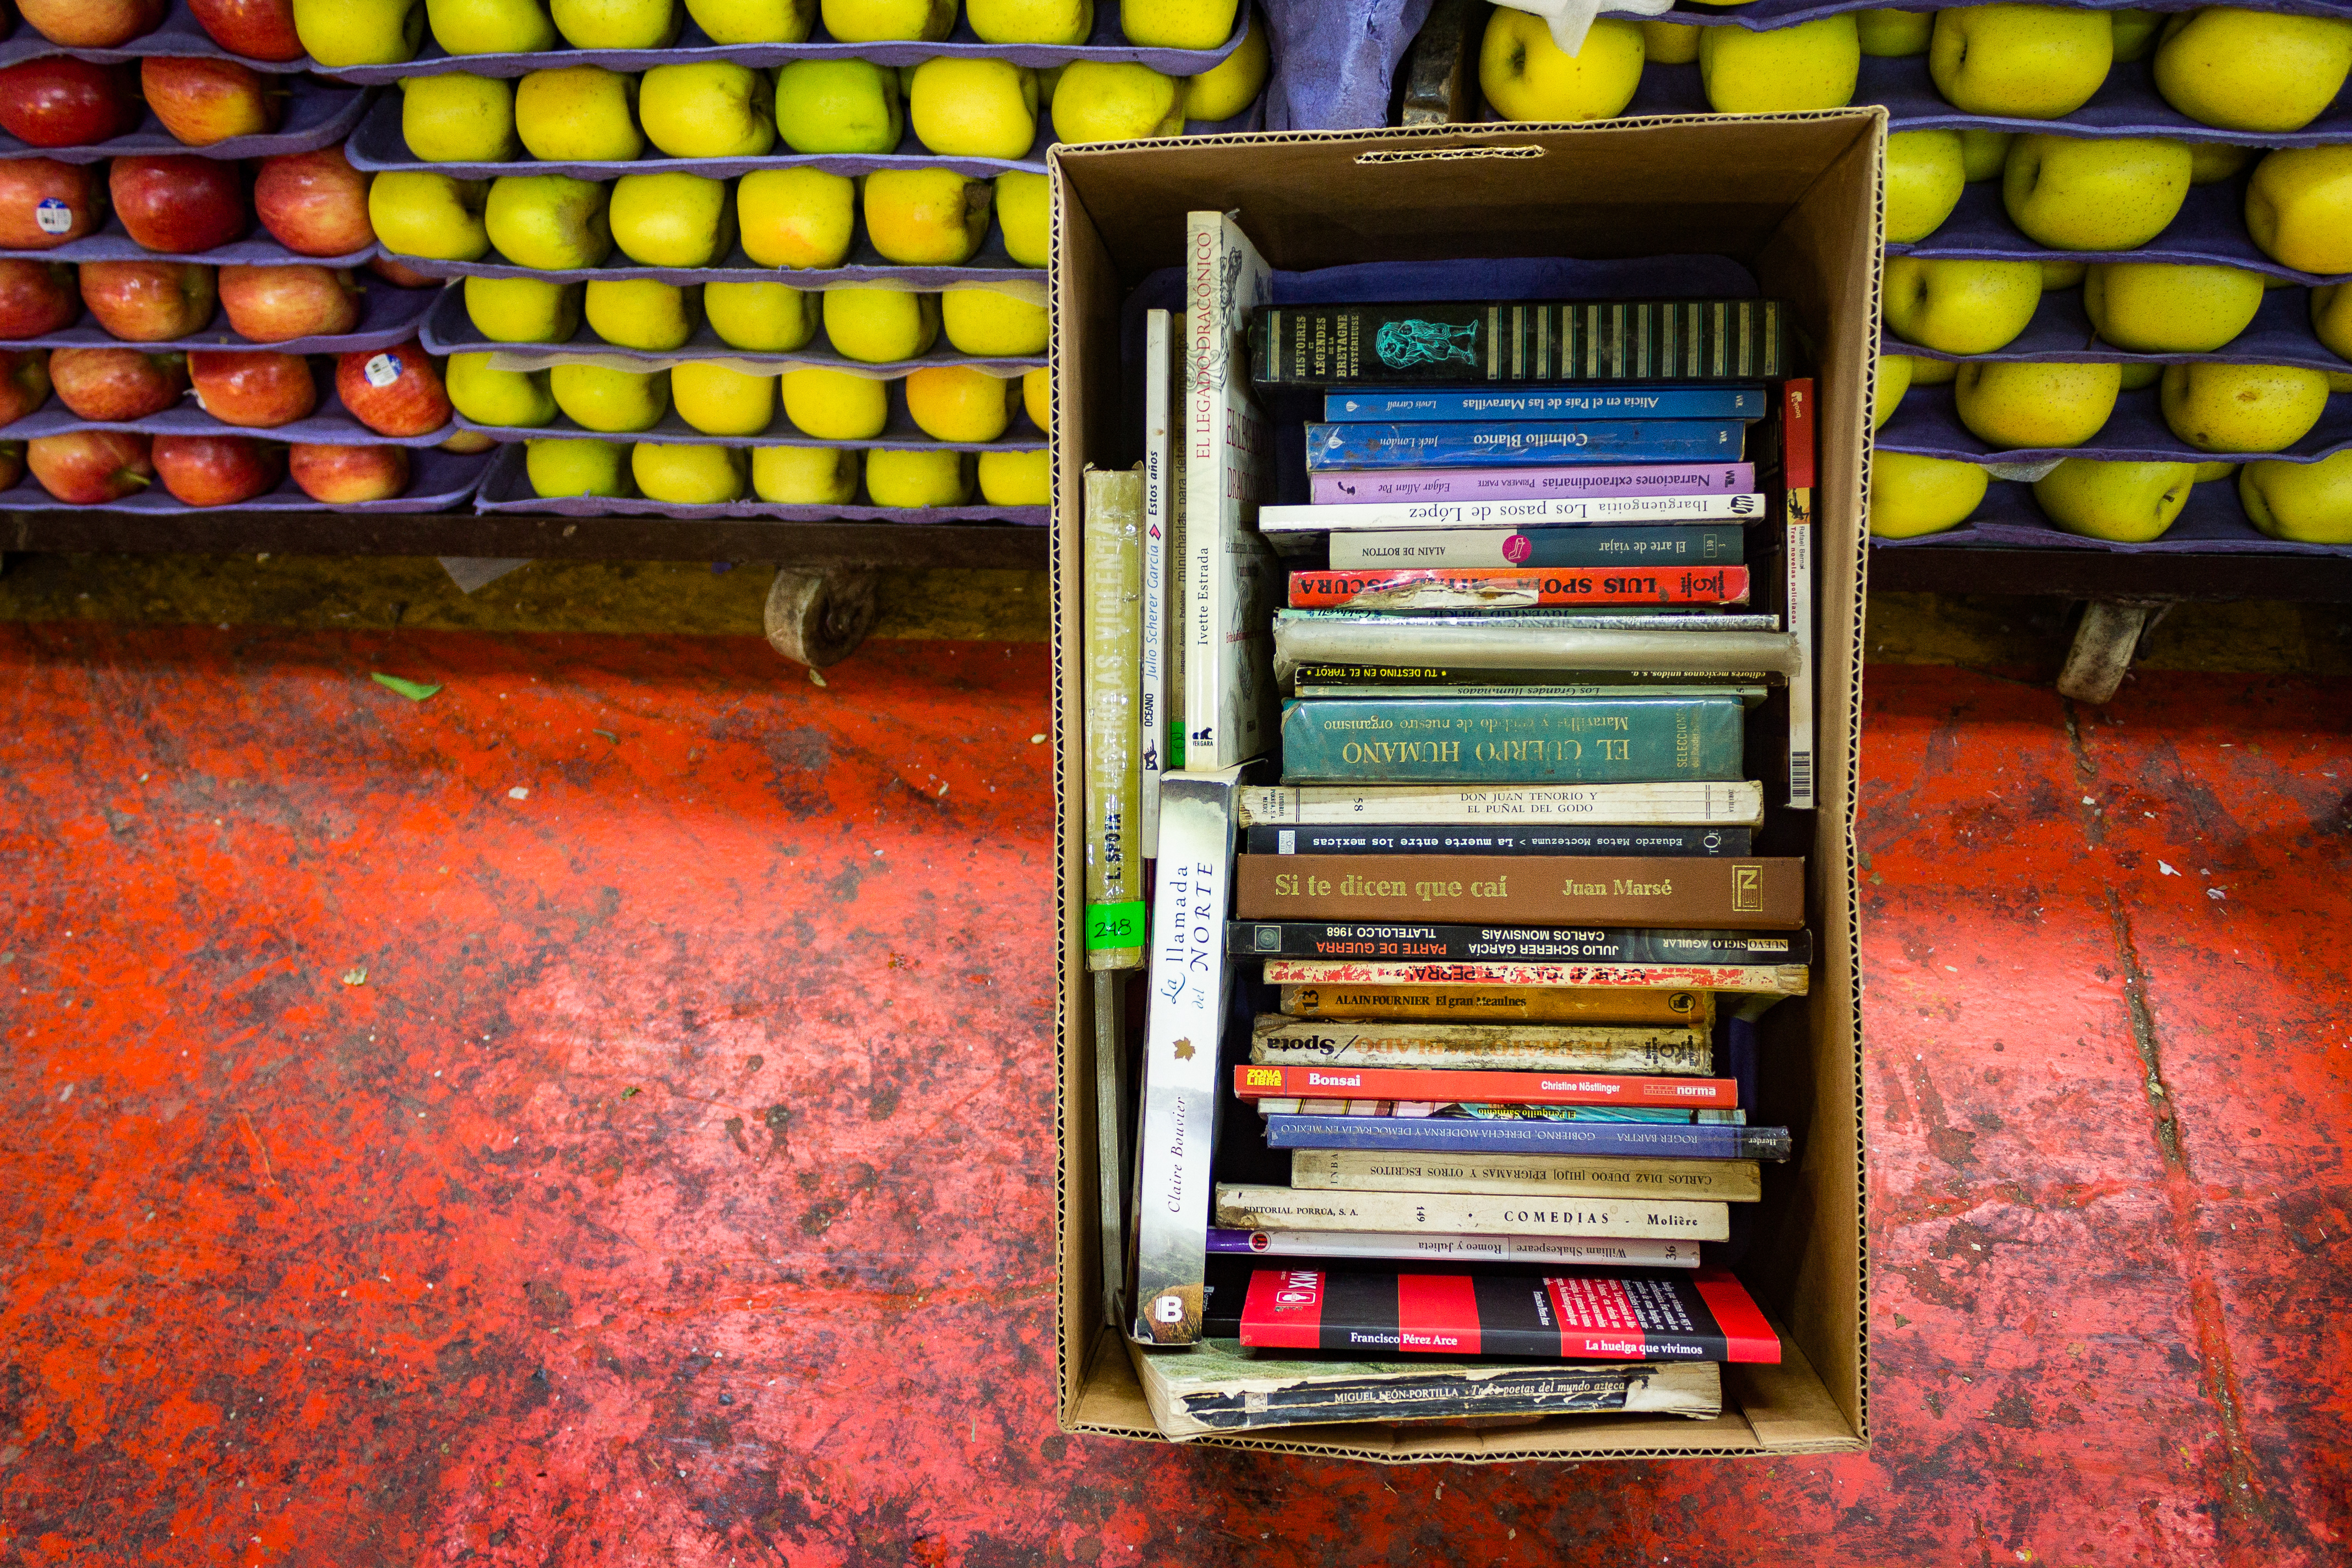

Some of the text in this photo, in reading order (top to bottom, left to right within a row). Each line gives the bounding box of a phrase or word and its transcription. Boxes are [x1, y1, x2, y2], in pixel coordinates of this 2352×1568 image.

[1193, 232, 1211, 458] EL LEGADO DRACÓNICO
[1297, 317, 1305, 376] HISTOIRES
[1315, 318, 1325, 375] LÉGENDES
[1337, 315, 1347, 377] BRETAGNE
[1463, 398, 1659, 410] Alicia en el País de las Maravillas
[1380, 435, 1439, 448] Jack London
[1473, 434, 1587, 447] Colmillo Blanco
[1148, 451, 1158, 515] Estos años
[1379, 479, 1450, 494] Edgar Allan Poe
[1543, 477, 1631, 490] extraordinarias
[1636, 474, 1709, 487] Narraciones
[1409, 499, 1708, 521] Ibargüengoitia Los pasos de López
[1363, 548, 1400, 556] BOTTON
[1403, 547, 1414, 556] DE
[1599, 540, 1686, 554] El arte de viajar
[1198, 548, 1208, 645] Ivette Estrada
[1145, 545, 1159, 680] Julio Scherer García
[1145, 694, 1153, 727] OCEANO
[1342, 739, 1630, 763] EL CUERPO HUMANO
[1461, 793, 1486, 802] DON
[1492, 793, 1522, 803] JUAN
[1487, 804, 1524, 812] PUÑAL
[1313, 839, 1365, 847] mexicas
[1372, 839, 1393, 847] los
[1498, 839, 1513, 847] La
[1276, 873, 1507, 901] Si te dicen que caí
[1563, 879, 1672, 895] Juan Marsé
[1161, 867, 1187, 1004] La llamada
[1190, 863, 1212, 1009] del NORTE
[1327, 927, 1604, 941] CARLOS MONSIVÁIS TLATELOLCO 1968
[1316, 942, 1619, 956] JULIO SCHERER GARCÍA PARTE DE GUERRA
[1663, 939, 1787, 949] NUEVO SIGLO AGUILAR
[1336, 995, 1370, 1004] ALAIN
[1373, 996, 1430, 1006] FOURNIER
[1436, 997, 1448, 1006] El
[1449, 997, 1473, 1008] gran
[1248, 1069, 1281, 1078] ZONA
[1247, 1076, 1281, 1086] LIBRE
[1309, 1073, 1620, 1094] Bonsai Christine Nöstlinger
[1478, 1109, 1520, 1118] Sarmiento
[1522, 1108, 1565, 1119] Periquillo
[1168, 1097, 1185, 1212] Claire Bouvier
[1371, 1167, 1711, 1184] CARLOS DIAZ DUFOO [HIJO] EPIGRAMAS Y OTROS ESCRITOS
[1505, 1211, 1697, 1226] COMEDIAS Molière
[1419, 1241, 1626, 1258] William Shakespeare Romeo y Julieta
[1156, 1297, 1182, 1322] B
[1351, 1332, 1457, 1346] Francisco Pérez Arce
[1585, 1340, 1703, 1354] La huelga que vivimos
[1503, 1384, 1534, 1396] poetas
[1538, 1382, 1553, 1393] del
[1558, 1381, 1590, 1392] mundo
[1594, 1382, 1625, 1390] azteca
[1335, 1392, 1375, 1403] MIGUEL
